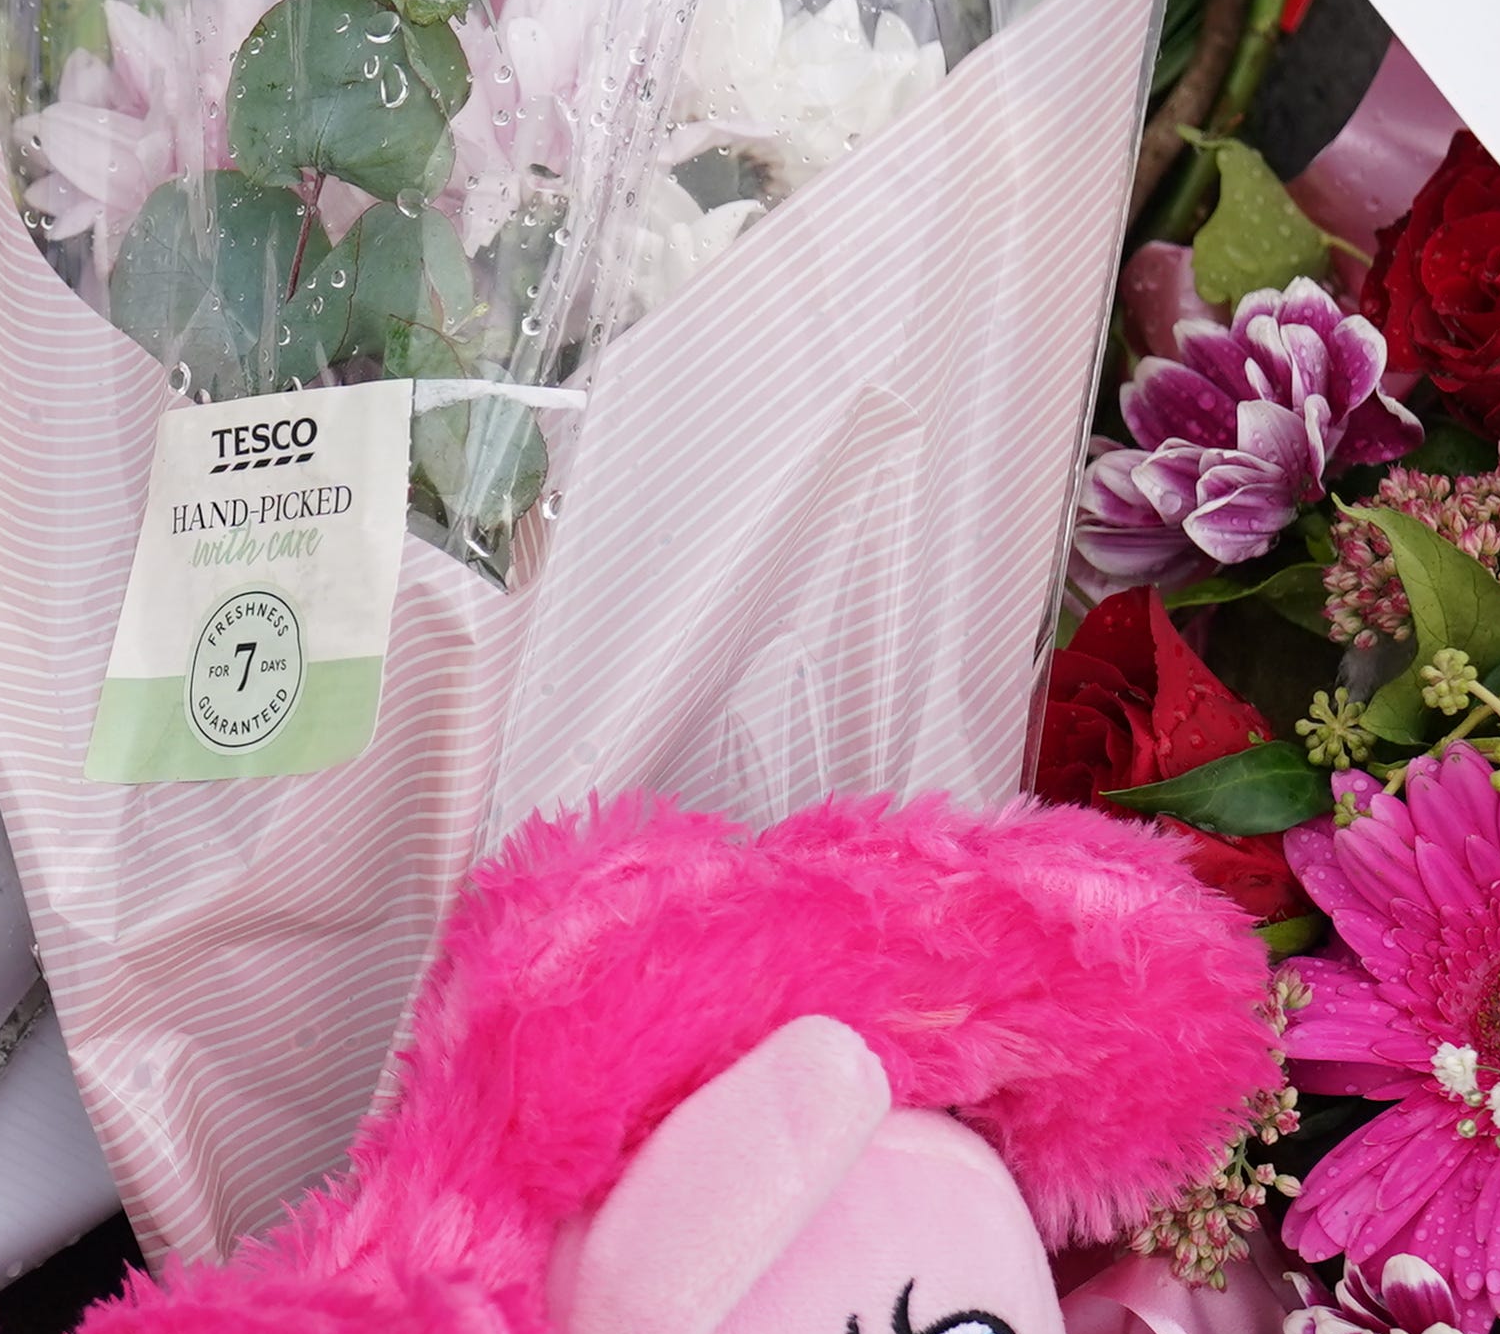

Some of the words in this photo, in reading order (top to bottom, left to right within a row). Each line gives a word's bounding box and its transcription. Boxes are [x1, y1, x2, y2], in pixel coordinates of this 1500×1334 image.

[211, 417, 318, 459] TESCO
[172, 485, 353, 535] HAND-PICKED
[192, 526, 266, 567] with
[266, 527, 325, 559] care
[208, 602, 290, 647] FRESHNESS
[208, 664, 230, 679] FOR
[233, 641, 258, 693] 7
[260, 658, 288, 674] DAYS
[198, 687, 289, 736] GUARANTEED
